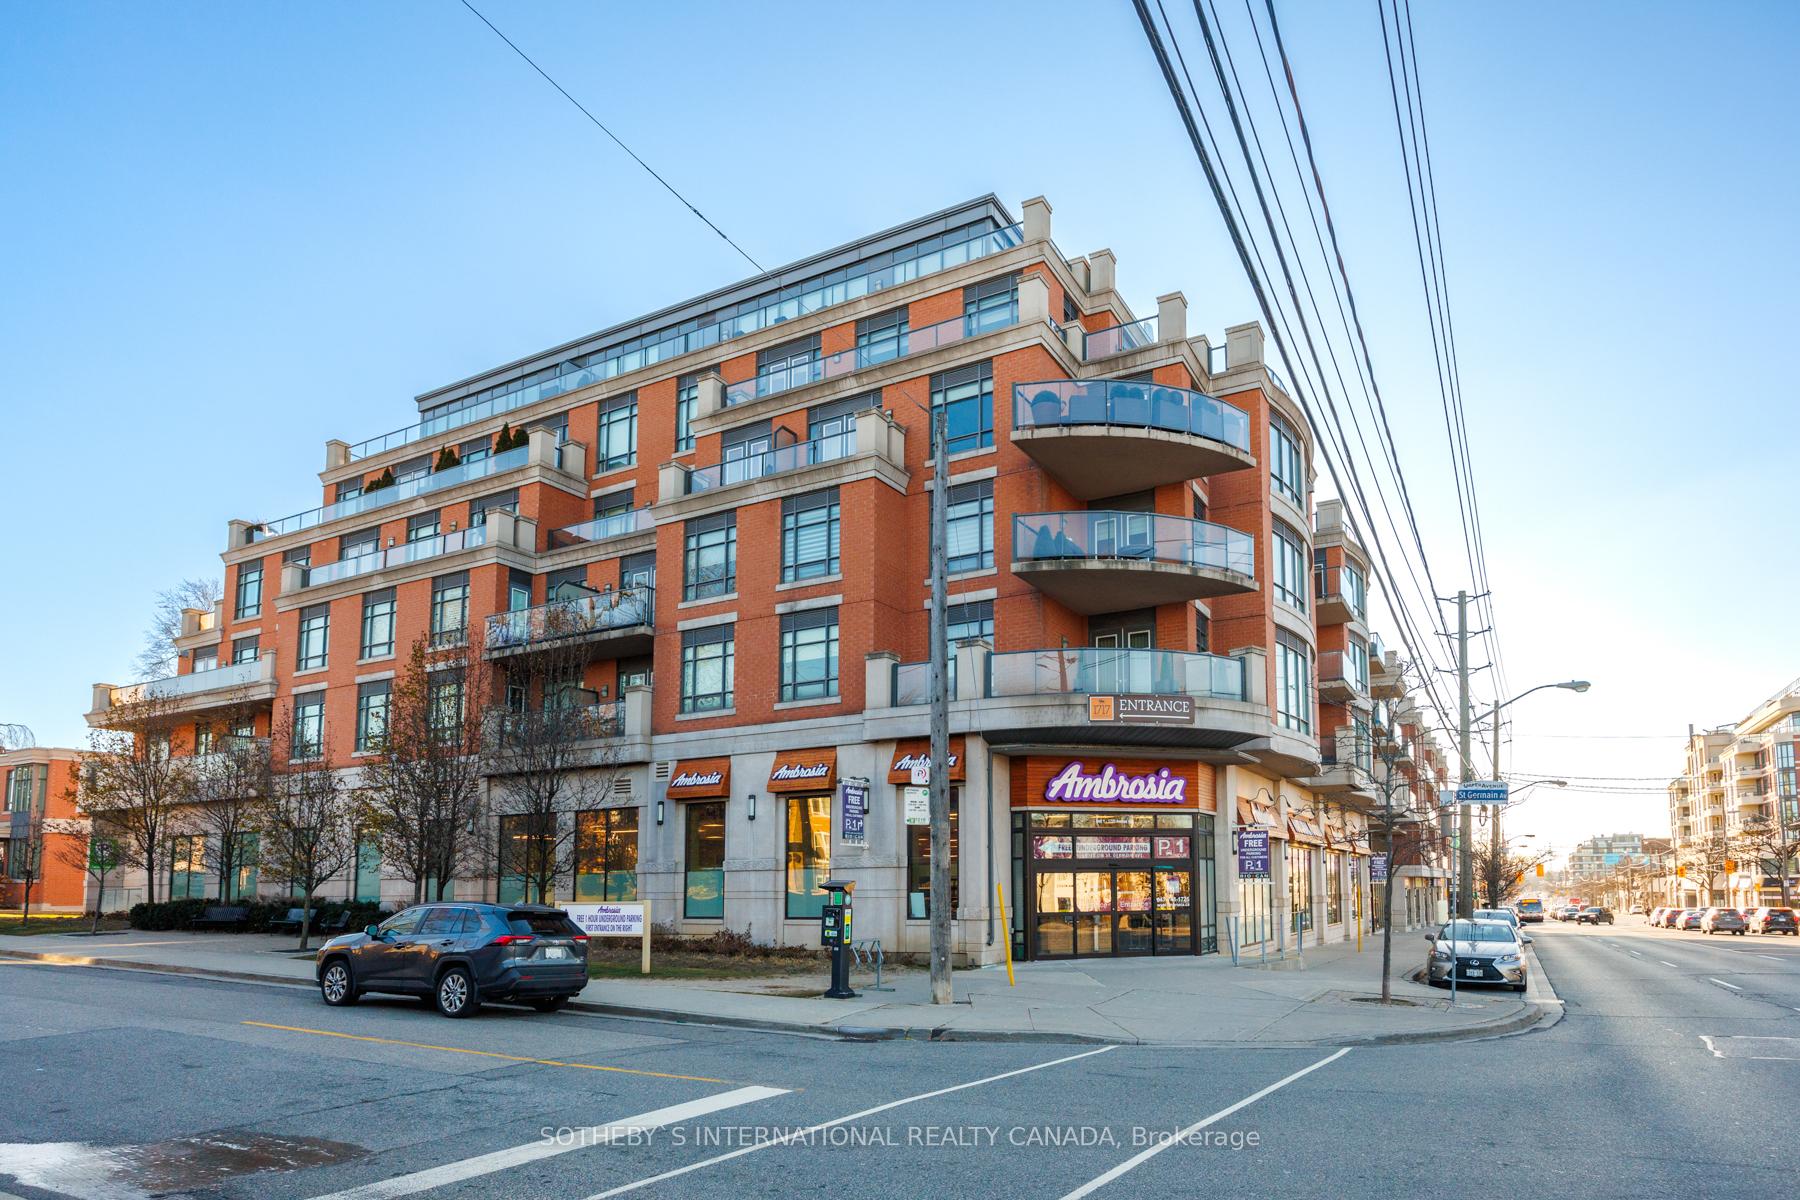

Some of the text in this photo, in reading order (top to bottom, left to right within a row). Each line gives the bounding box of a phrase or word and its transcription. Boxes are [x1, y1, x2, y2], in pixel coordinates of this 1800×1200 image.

[1093, 704, 1111, 715] 1717
[1119, 699, 1190, 713] ENTRANCE
[771, 763, 829, 780] Ambrosia
[671, 771, 723, 787] Ambrosia
[1046, 762, 1187, 802] Ambrosia
[848, 795, 861, 805] FREE
[1458, 791, 1466, 799] St
[1467, 791, 1498, 799] Germain
[1158, 838, 1184, 856] P 1
[1244, 839, 1263, 848] FREE
[577, 914, 585, 923] FREE
[588, 914, 598, 923] HOUR
[599, 914, 626, 923] UNDERGROUND
[627, 914, 643, 923] PARKING
[594, 924, 610, 932] ENTRANCE
[610, 924, 616, 932] ON
[622, 924, 633, 932] RIGHT
